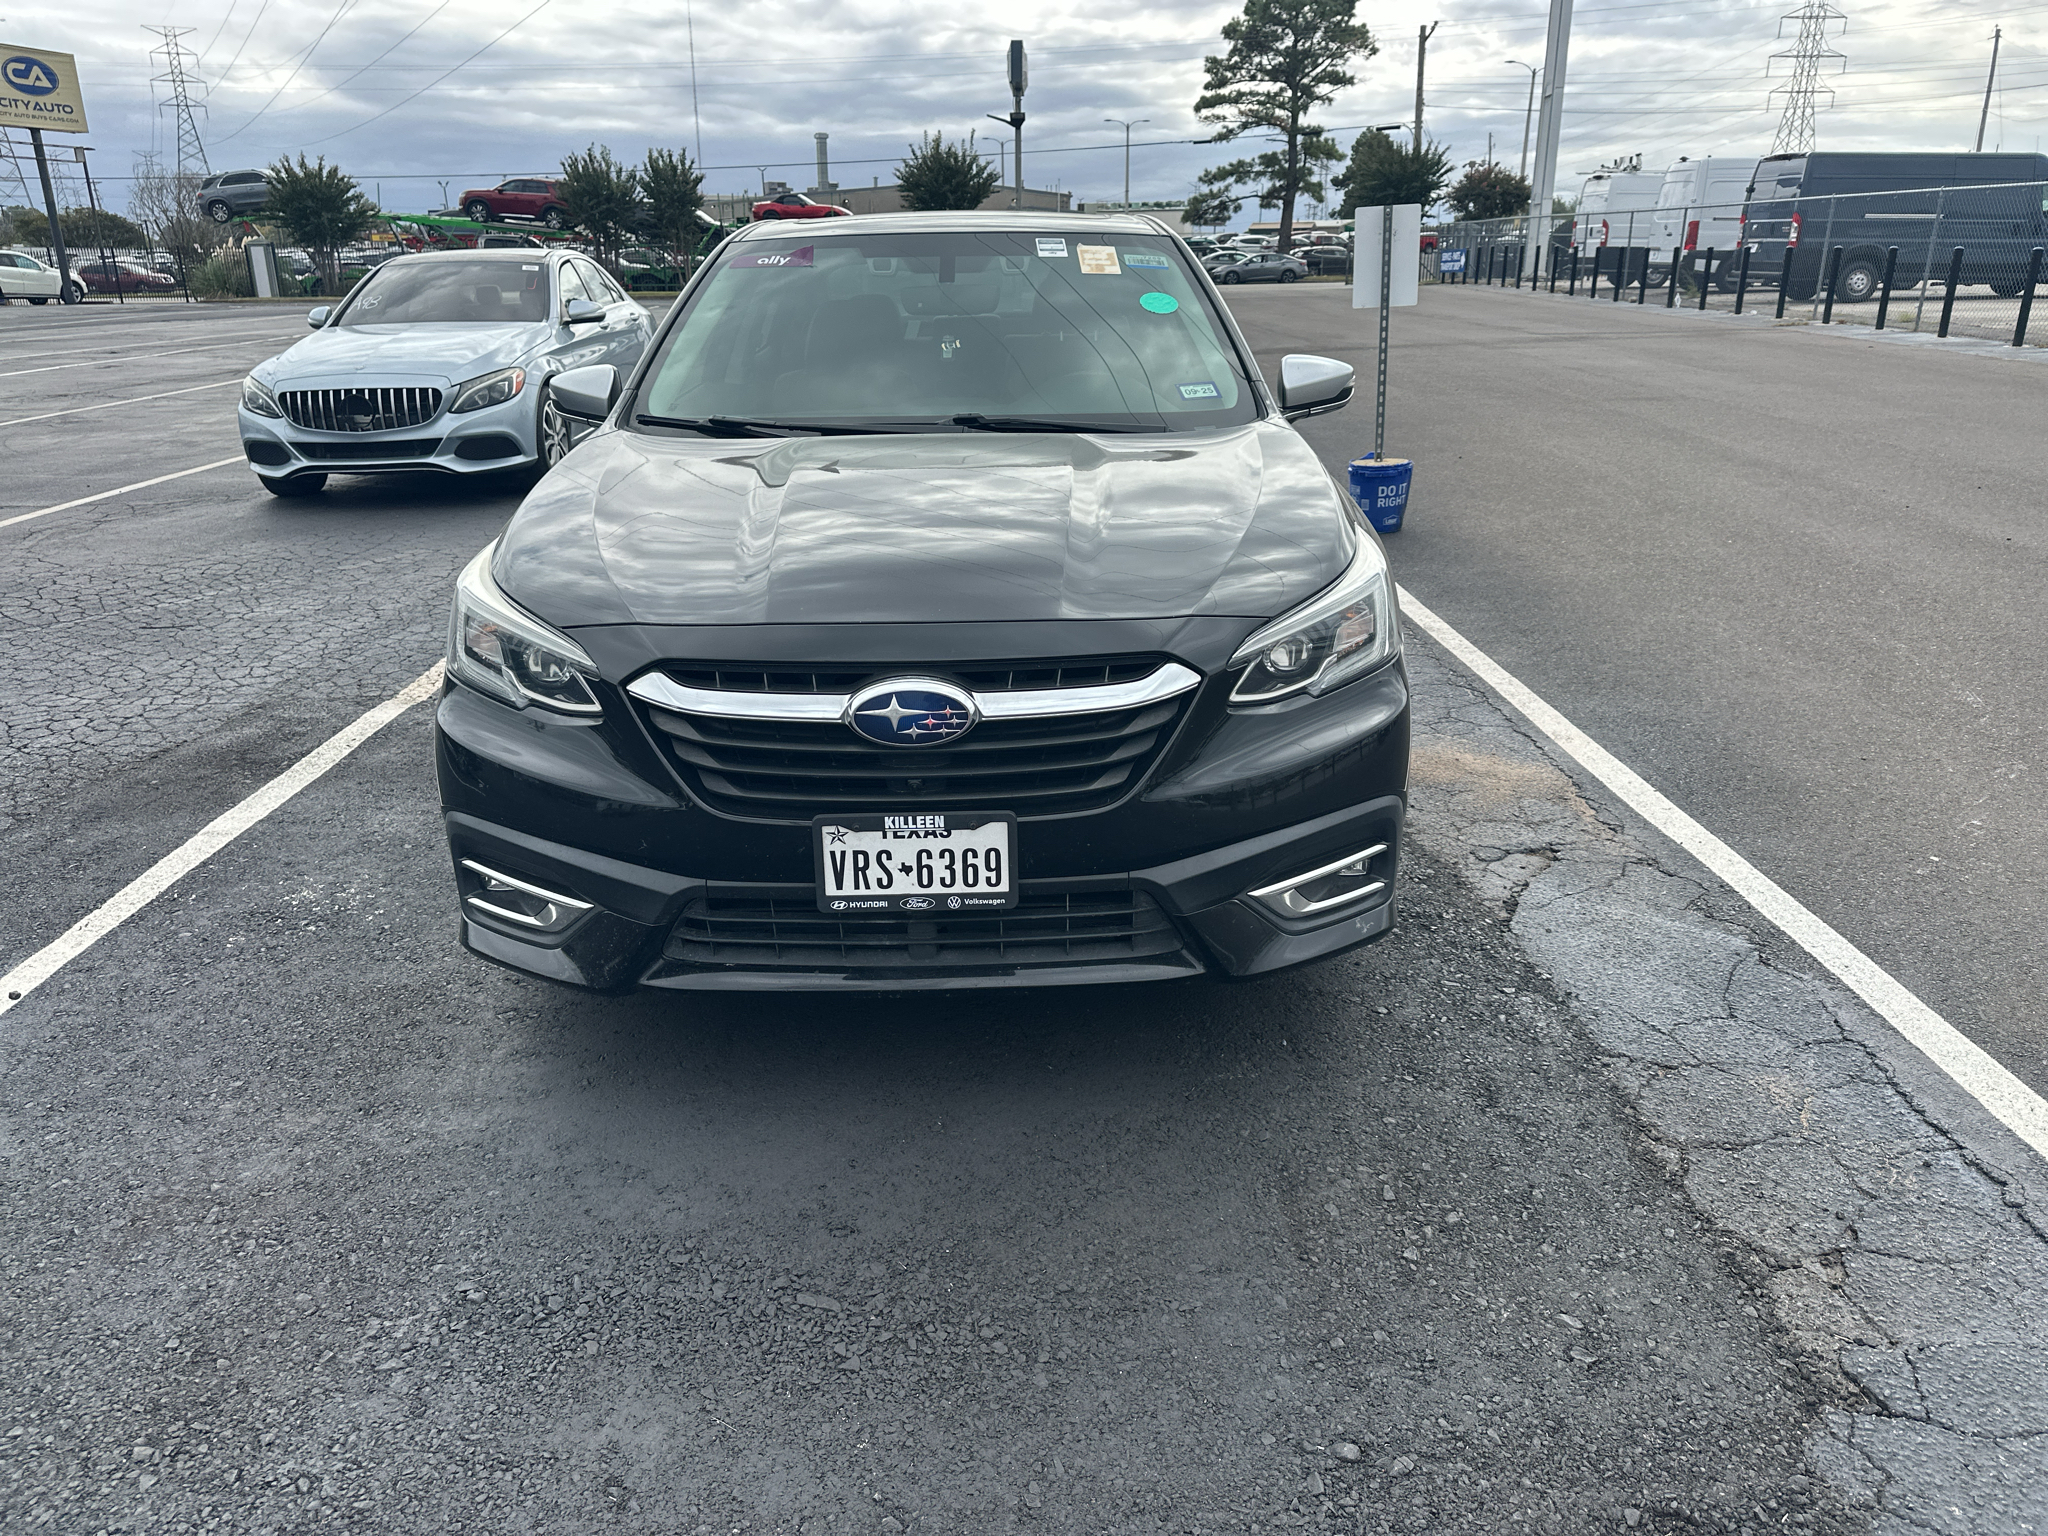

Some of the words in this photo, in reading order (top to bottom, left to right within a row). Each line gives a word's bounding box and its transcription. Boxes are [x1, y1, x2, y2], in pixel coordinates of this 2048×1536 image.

[6, 62, 53, 88] CA
[0, 97, 31, 110] CITY
[33, 101, 74, 115] AUTO
[757, 255, 791, 266] ally
[1378, 485, 1397, 497] DO
[1398, 482, 1408, 495] IT
[1377, 494, 1407, 508] RIGHT
[884, 815, 945, 829] KILLEEN
[849, 900, 888, 908] HYUNDAI
[906, 897, 929, 908] Ford
